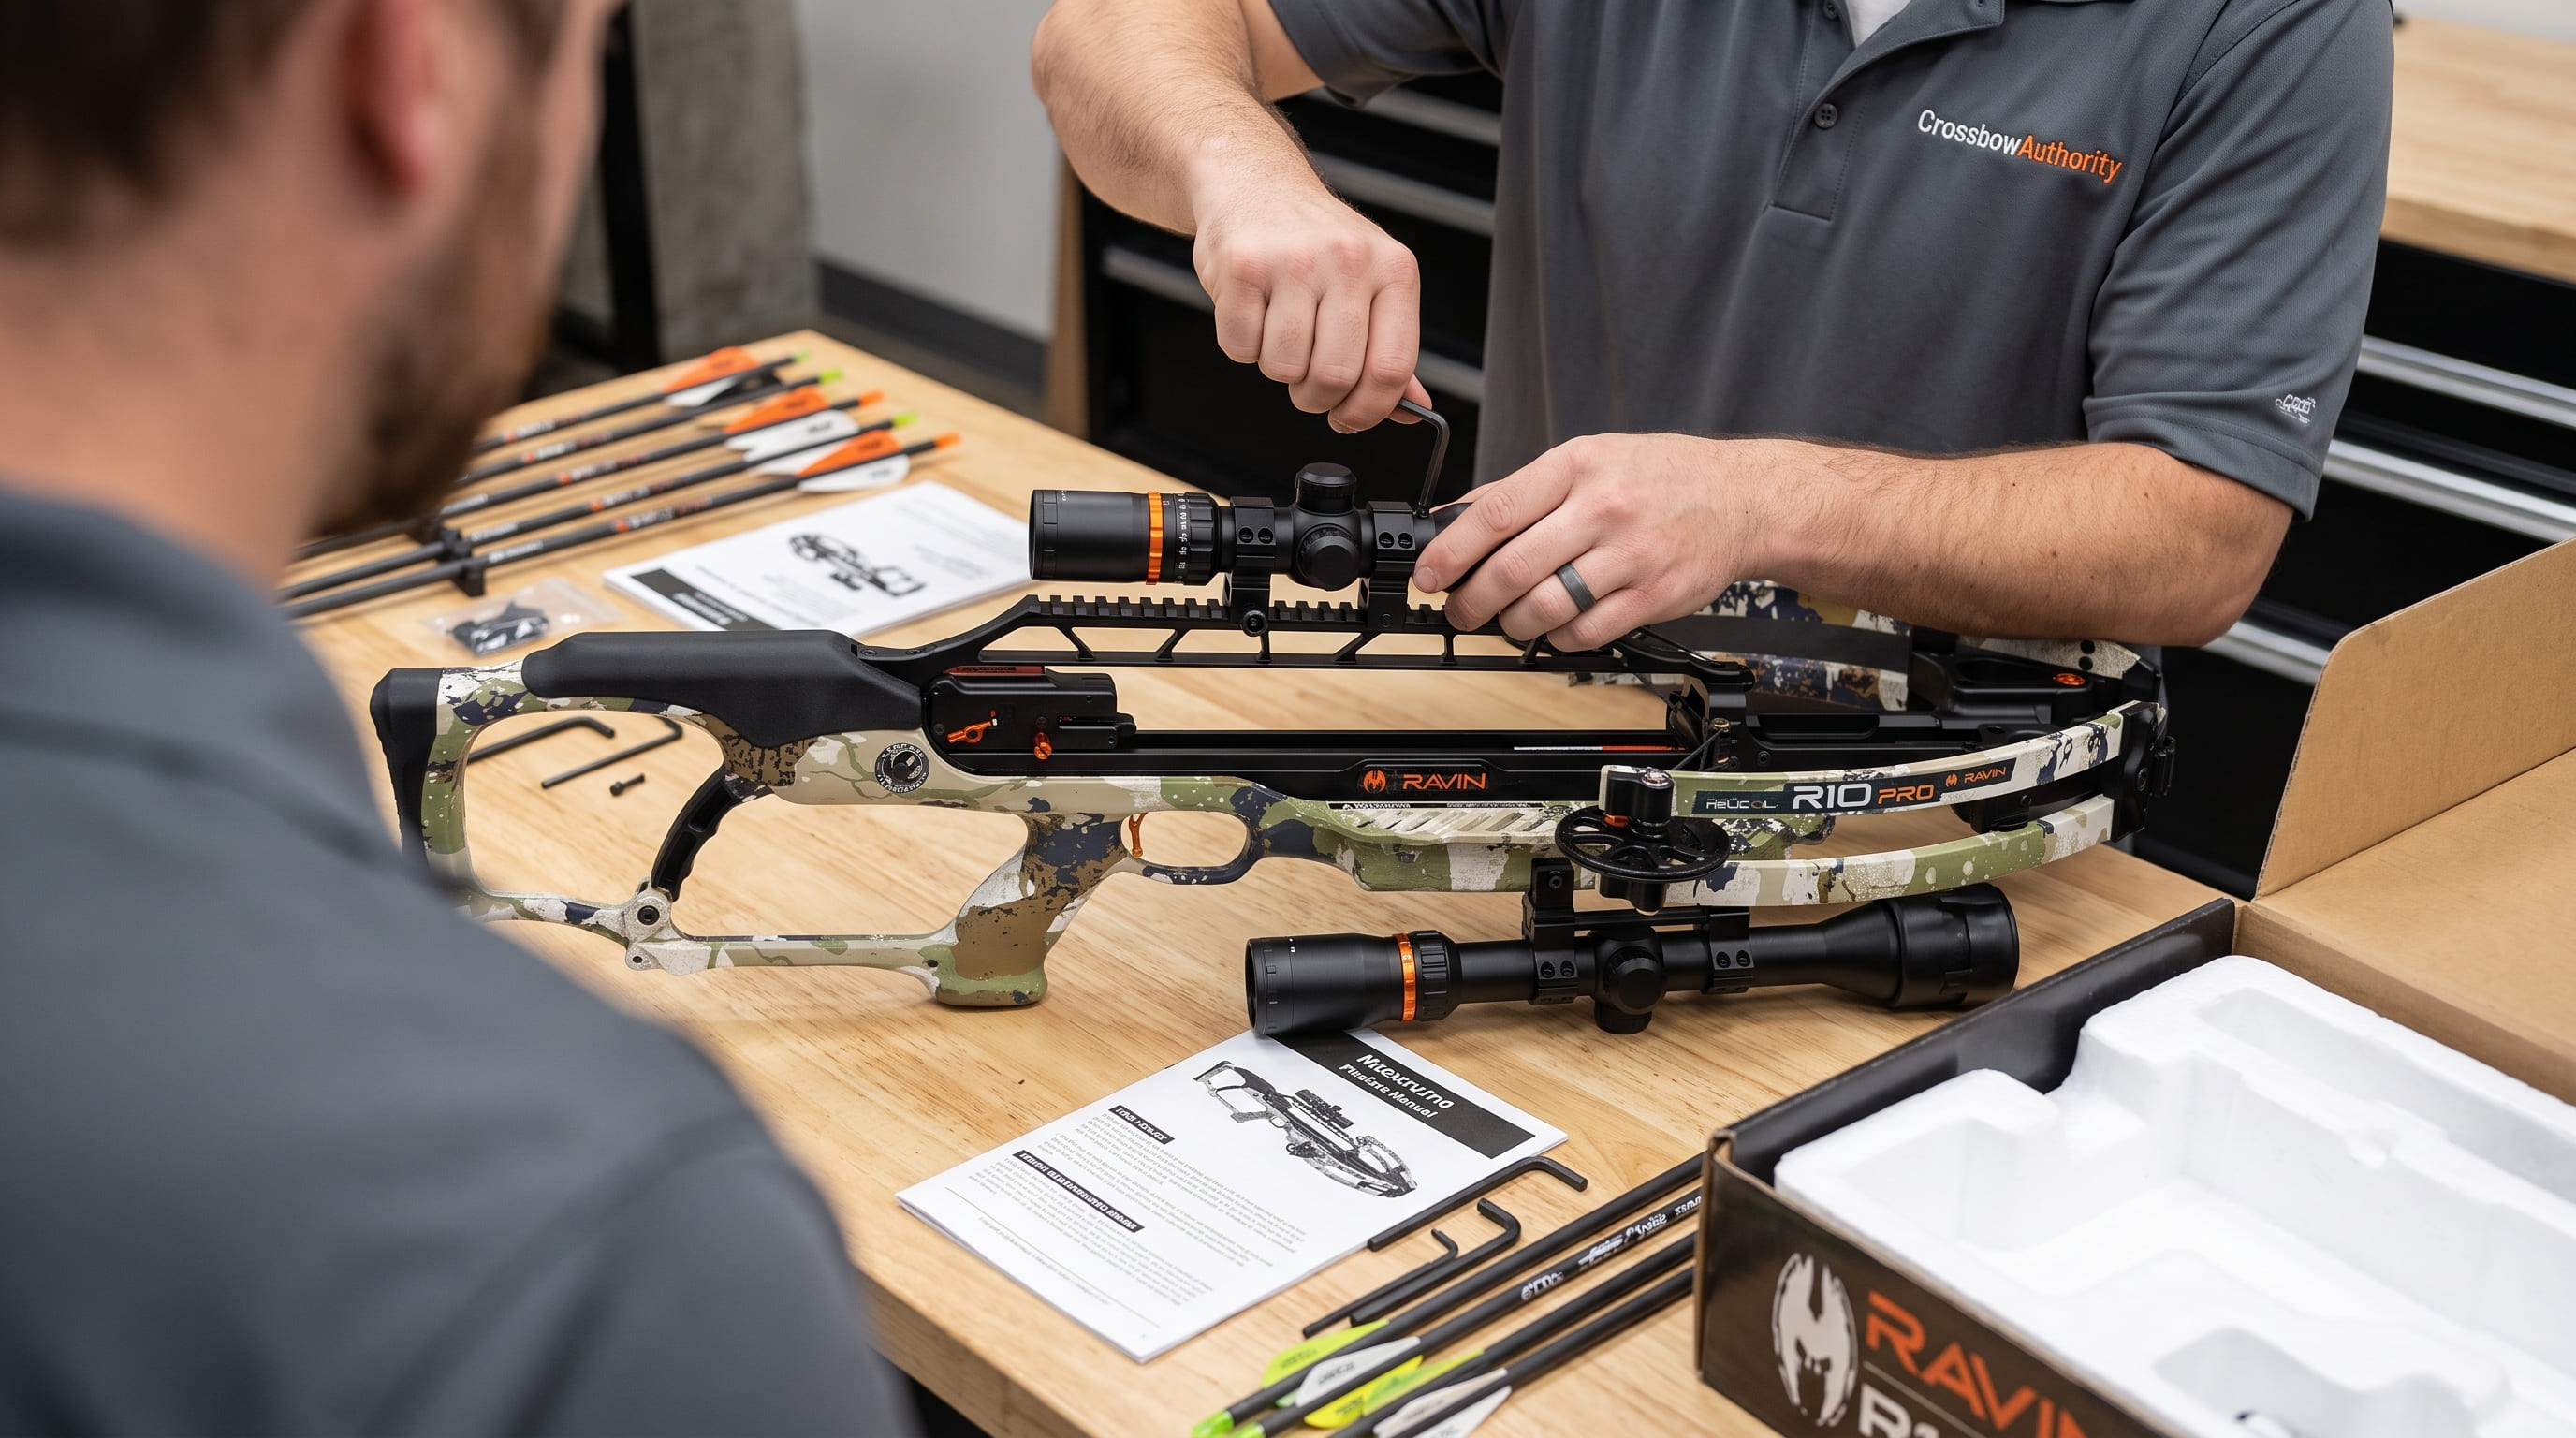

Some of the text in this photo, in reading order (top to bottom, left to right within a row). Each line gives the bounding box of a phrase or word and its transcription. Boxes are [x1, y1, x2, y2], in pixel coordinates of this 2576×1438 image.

[1918, 110, 2123, 183] CrossbowAuthority
[1402, 773, 1486, 790] RAVIN
[1964, 766, 2006, 784] RAVIN
[1793, 783, 1935, 810] R10 PRO
